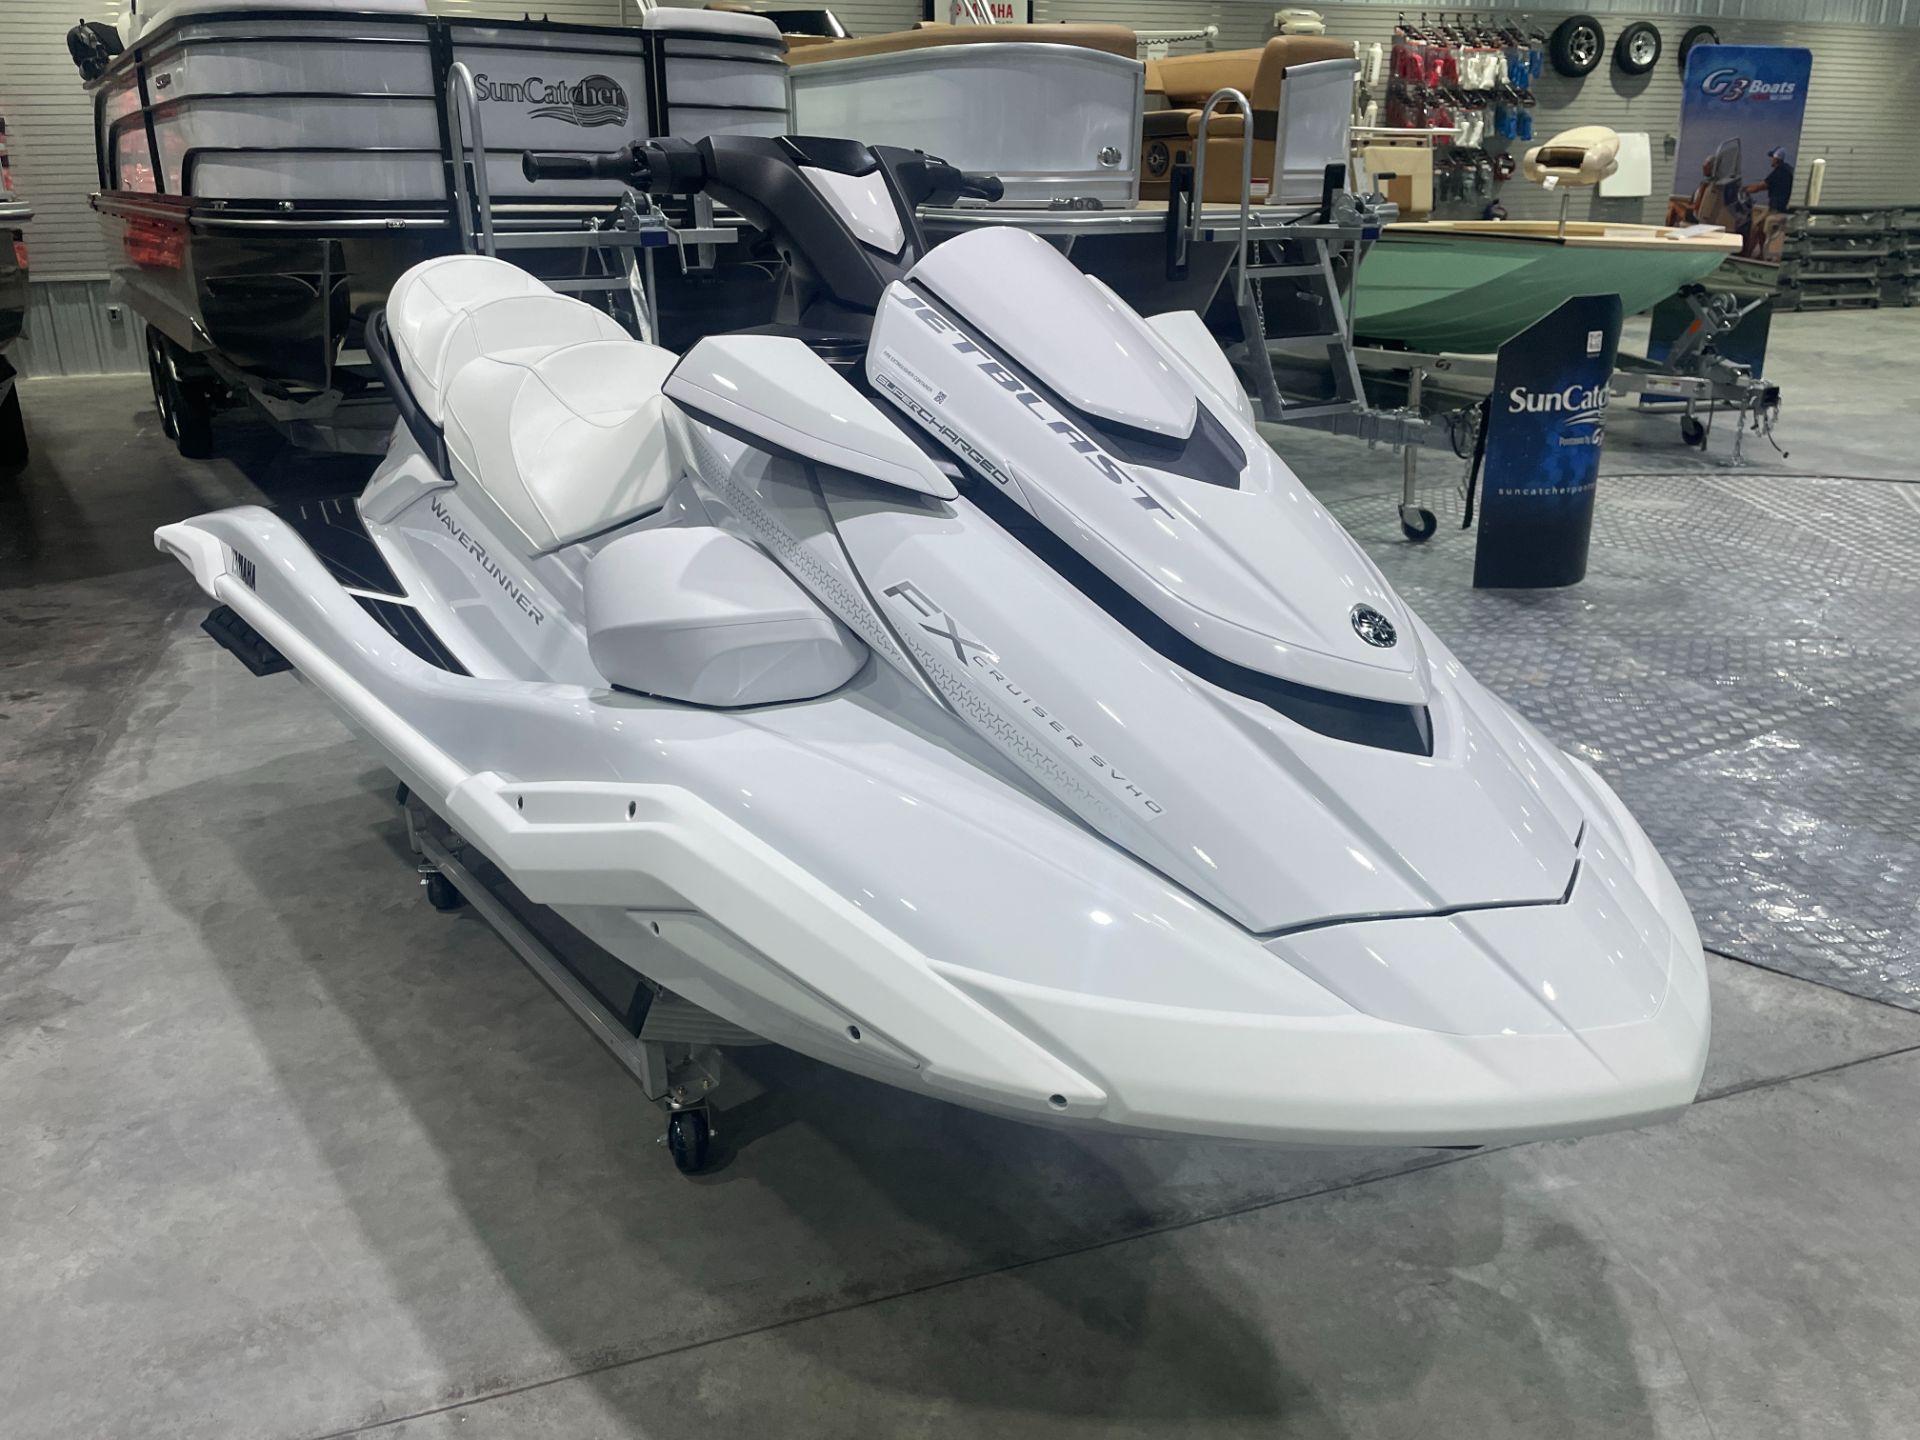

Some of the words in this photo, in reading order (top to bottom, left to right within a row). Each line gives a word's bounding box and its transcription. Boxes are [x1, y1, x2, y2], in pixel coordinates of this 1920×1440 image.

[474, 74, 623, 105] SunCatcher
[1701, 68, 1749, 102] G3
[1748, 79, 1796, 94] Boats
[875, 373, 1010, 486] SUPERCHARGED
[890, 292, 1176, 520] JETBLAST
[431, 495, 545, 626] WAVERUNNER
[883, 580, 994, 667] FX
[972, 655, 1084, 749] CRUISER
[1089, 754, 1163, 814] SVHO
